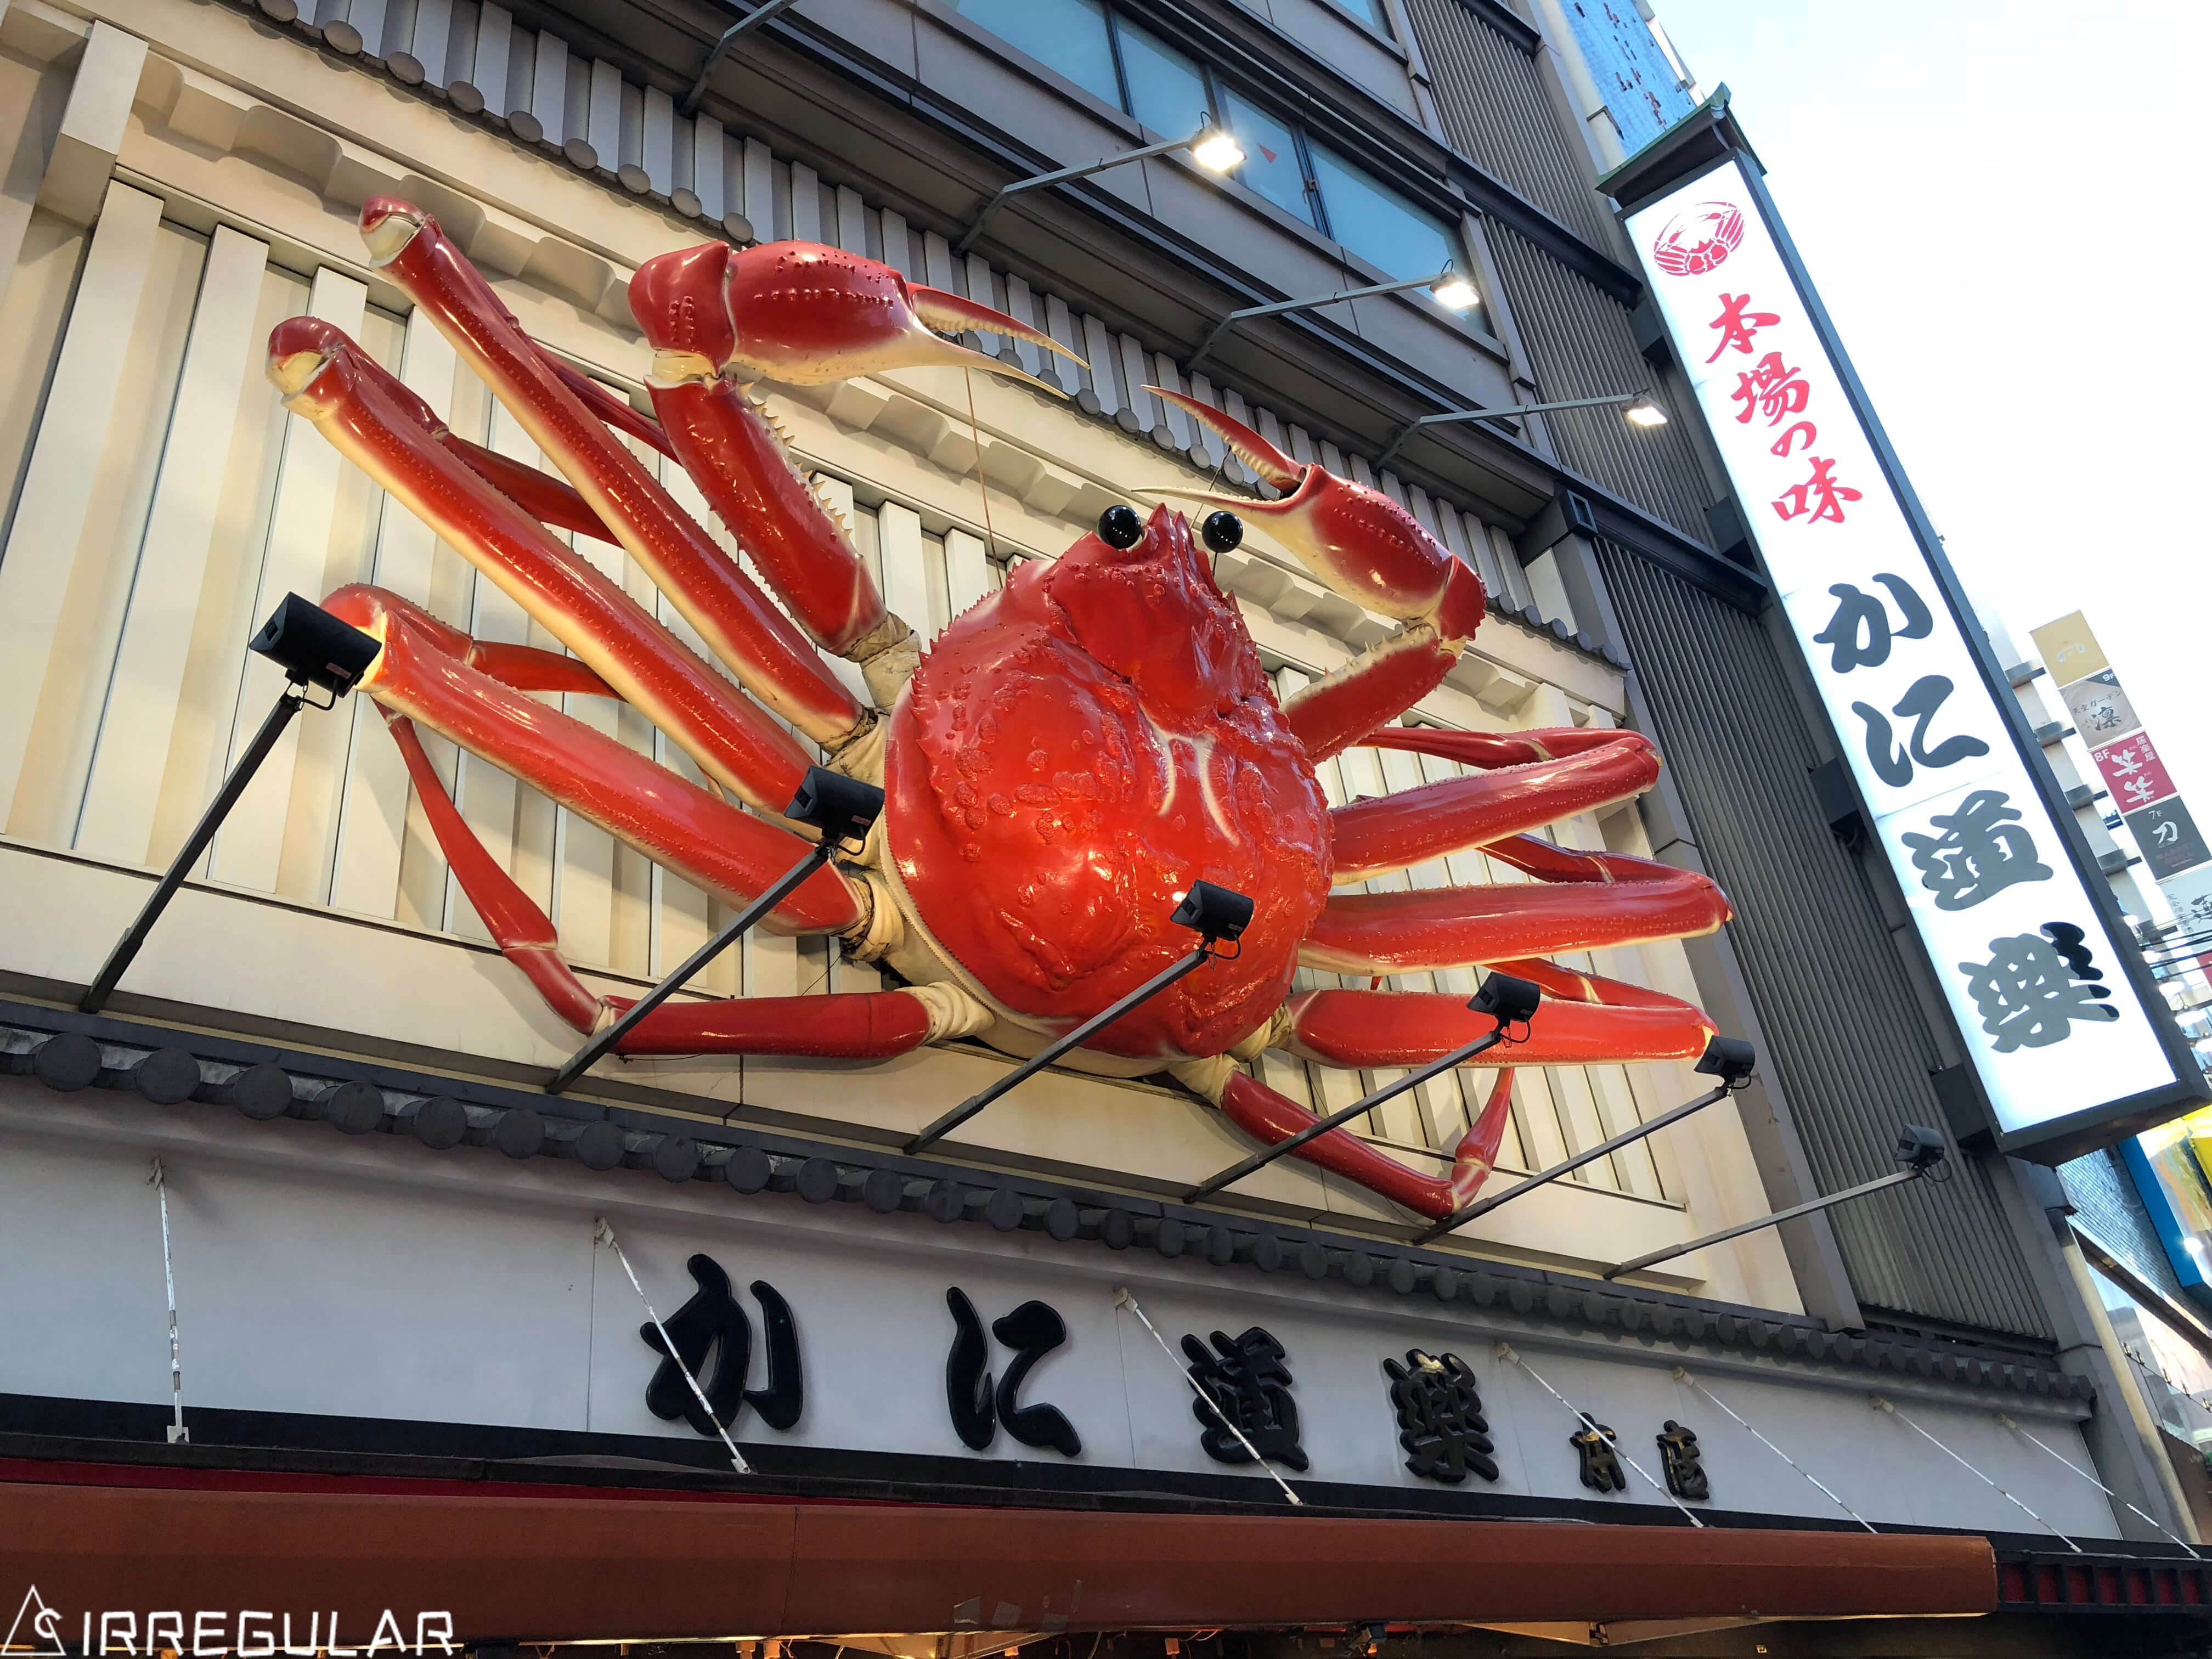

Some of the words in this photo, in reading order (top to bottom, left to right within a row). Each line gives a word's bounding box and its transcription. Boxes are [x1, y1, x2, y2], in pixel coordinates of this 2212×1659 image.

[1705, 292, 1863, 524] 本場の味
[2094, 748, 2111, 762] 8F
[2148, 810, 2163, 820] 7F
[2152, 821, 2179, 844] 刀
[1568, 1412, 1709, 1500] 本店
